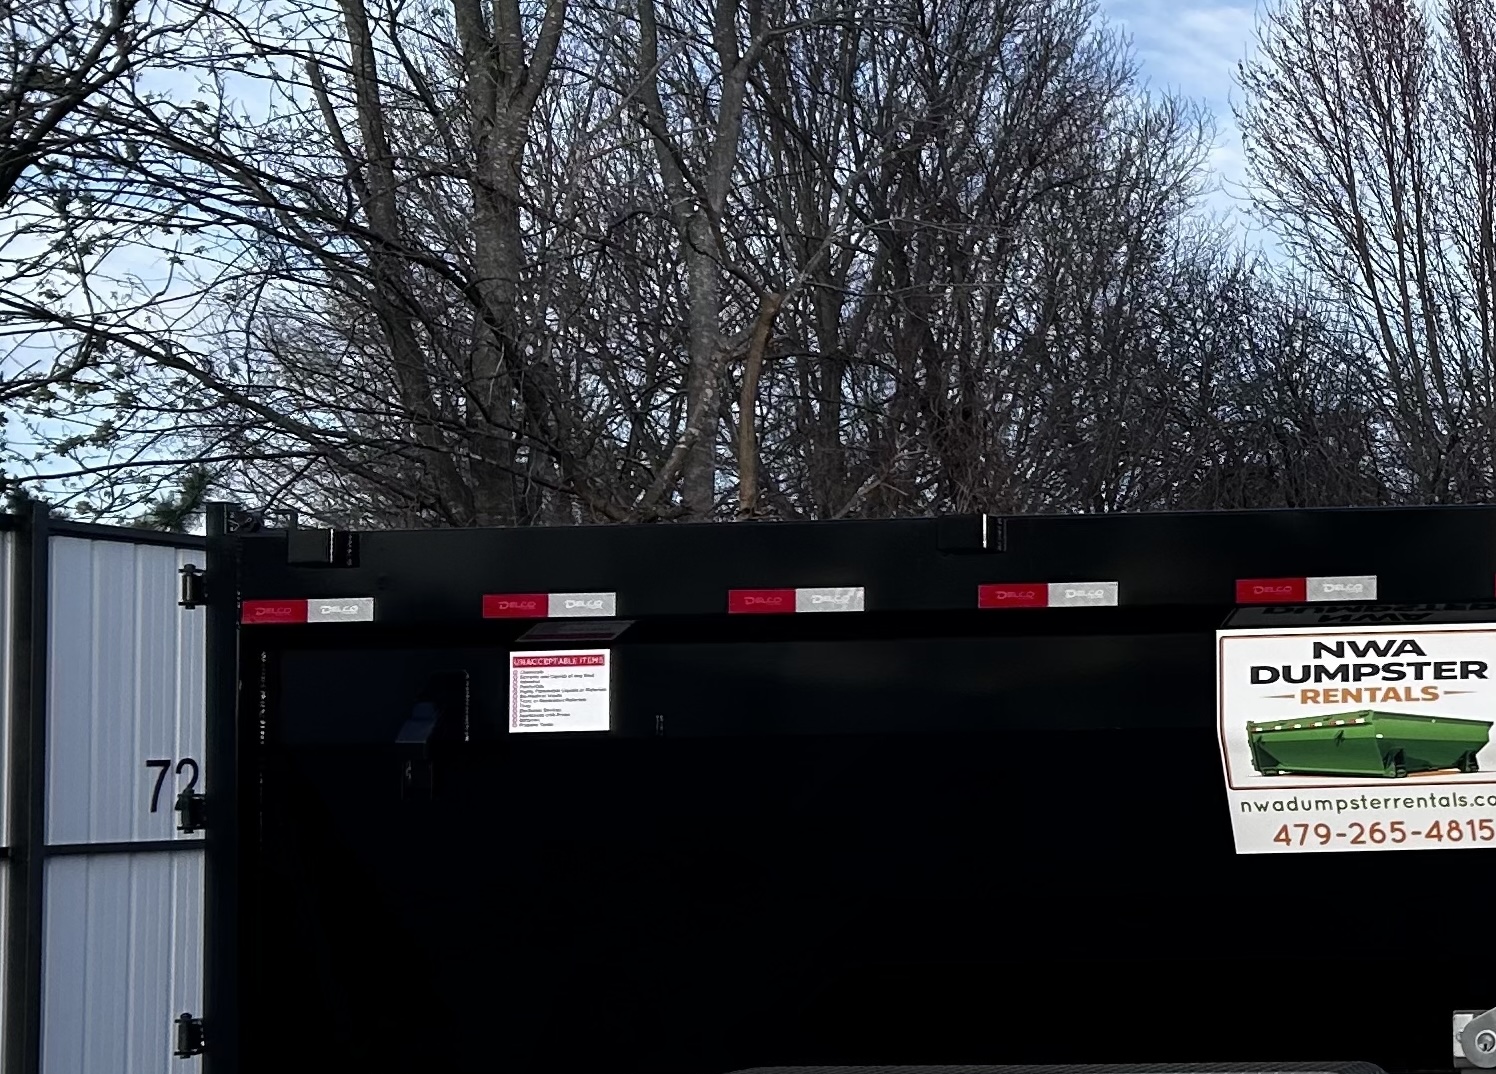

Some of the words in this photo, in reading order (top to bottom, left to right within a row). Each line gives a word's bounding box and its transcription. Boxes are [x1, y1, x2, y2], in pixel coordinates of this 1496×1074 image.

[1253, 585, 1293, 594] DELCO
[498, 600, 537, 610] DELCO
[564, 598, 604, 609] DELCO
[255, 607, 292, 616] DELCO
[1313, 638, 1427, 660] NWA
[513, 657, 577, 666] UNACCEPTABLE
[1250, 660, 1490, 685] DUMPSTER
[1300, 685, 1440, 705] RENTALS
[145, 758, 199, 813] 72
[1273, 819, 1496, 846] 479-265-4815
